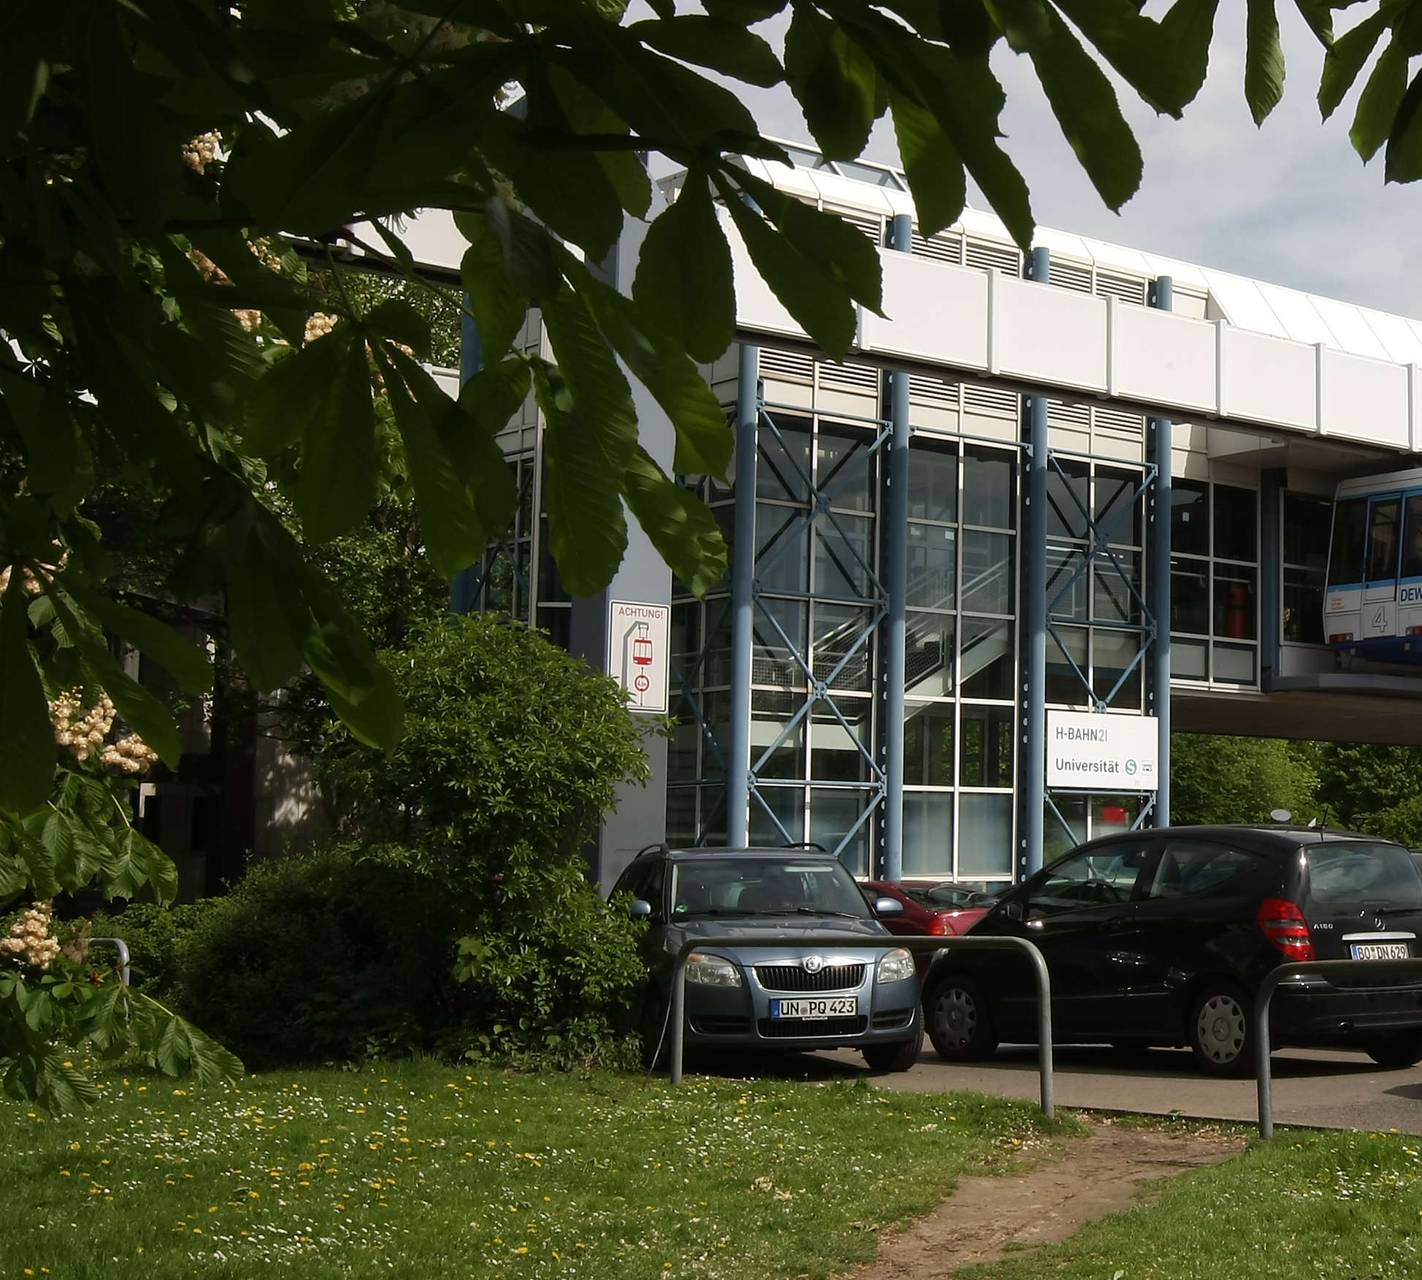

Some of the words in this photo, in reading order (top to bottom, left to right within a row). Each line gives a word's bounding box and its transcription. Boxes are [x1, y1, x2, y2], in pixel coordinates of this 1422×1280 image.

[618, 607, 663, 619] ACHTUNG!
[1371, 606, 1388, 633] 4
[1055, 758, 1120, 773] Universität
[1358, 946, 1371, 960] BO
[1377, 946, 1389, 960] DN
[1390, 946, 1406, 959] 629
[781, 1002, 799, 1016] UN
[809, 1001, 827, 1015] PQ
[829, 1000, 855, 1014] 423
